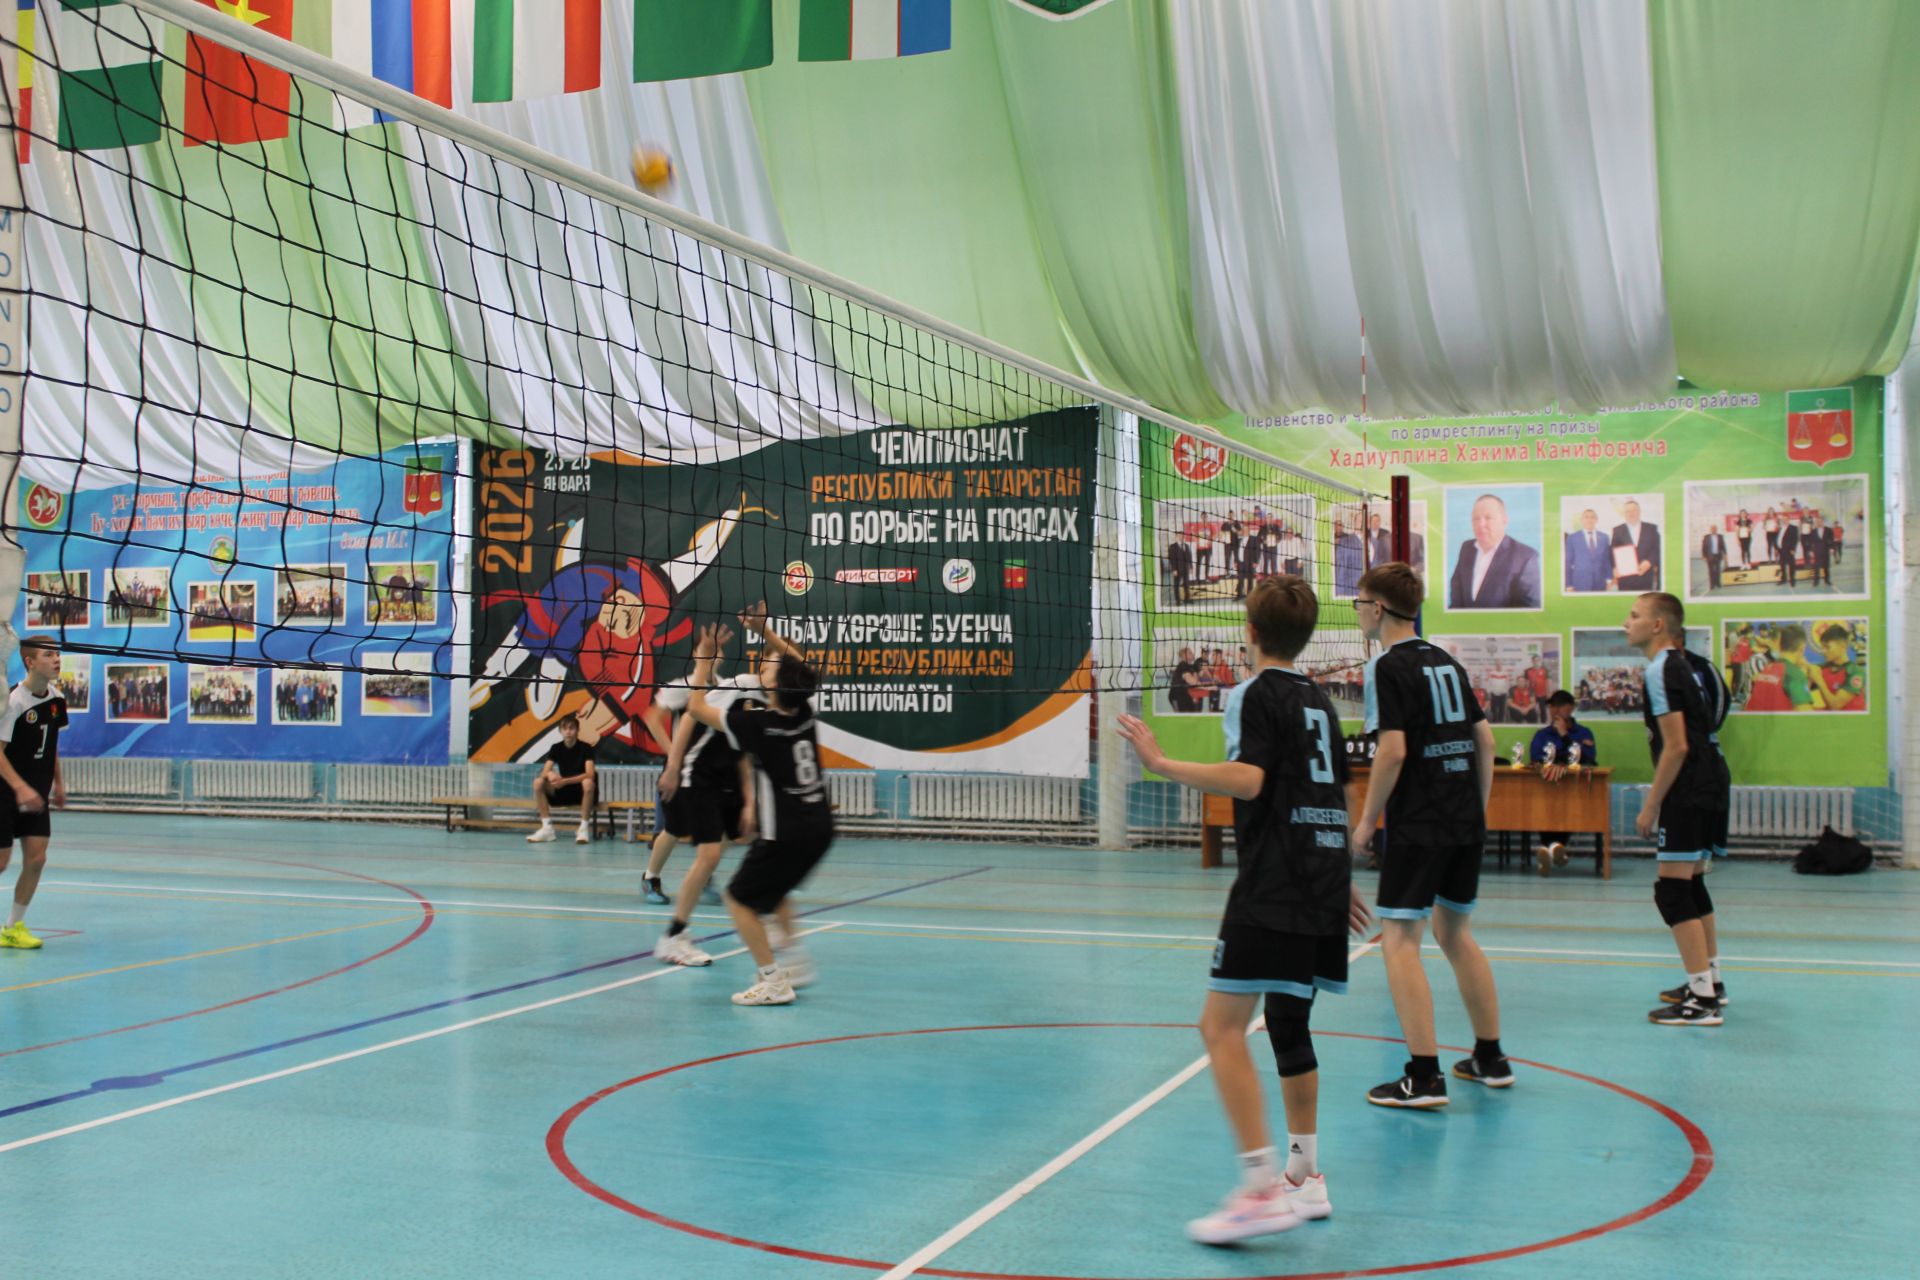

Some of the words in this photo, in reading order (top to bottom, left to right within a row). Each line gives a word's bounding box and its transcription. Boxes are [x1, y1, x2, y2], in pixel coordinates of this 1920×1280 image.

[1700, 391, 1760, 411] района
[871, 427, 1028, 465] ЧЕМПИОНАТ
[1391, 428, 1409, 440] по
[1414, 423, 1521, 441] армрестлингу
[1527, 423, 1544, 435] на
[1550, 421, 1600, 437] призы
[1330, 448, 1449, 470] Хадиуллина
[1456, 442, 1529, 462] Хакима
[1535, 437, 1667, 464] Канифовича
[543, 475, 591, 492] ЯНВАРЯ
[811, 470, 953, 503] РЕСПУБЛИКИ
[964, 466, 1081, 499] ТАТАРСТАН
[479, 449, 535, 573] 2026
[811, 512, 843, 546] ПО
[850, 508, 938, 545] БОРЬБЕ
[945, 507, 979, 543] НА
[987, 506, 1079, 542] ПОЯСАХ
[837, 570, 916, 582] МИНСПОРТ
[931, 613, 1013, 643] БУЕНЧА
[857, 648, 1013, 676] РЕСПУБЛИКАСЫ
[1423, 665, 1466, 724] 10
[1303, 707, 1335, 784] 3
[1346, 741, 1354, 753] 0
[1358, 741, 1364, 753] 1
[792, 740, 818, 785] 8
